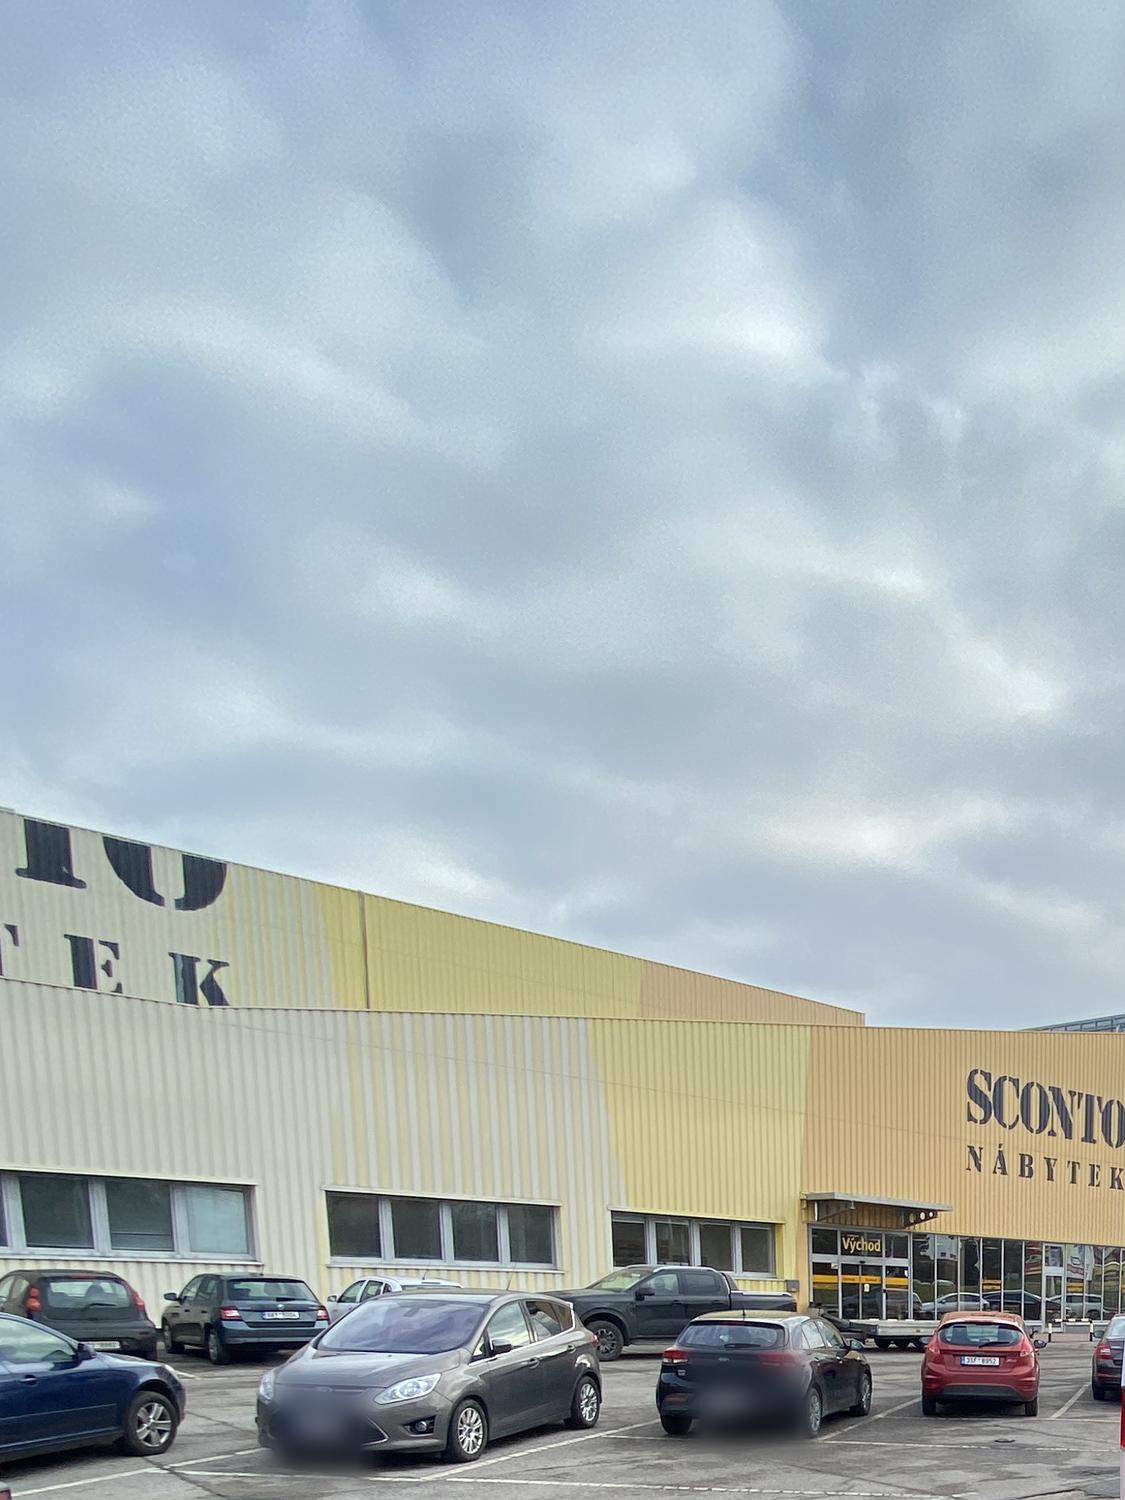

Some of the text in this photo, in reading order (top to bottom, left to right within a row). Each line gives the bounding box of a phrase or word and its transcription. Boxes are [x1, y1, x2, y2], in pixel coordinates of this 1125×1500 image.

[0, 924, 230, 1006] EK
[966, 1144, 1124, 1190] NÁBYTEK
[842, 1236, 881, 1253] Východ
